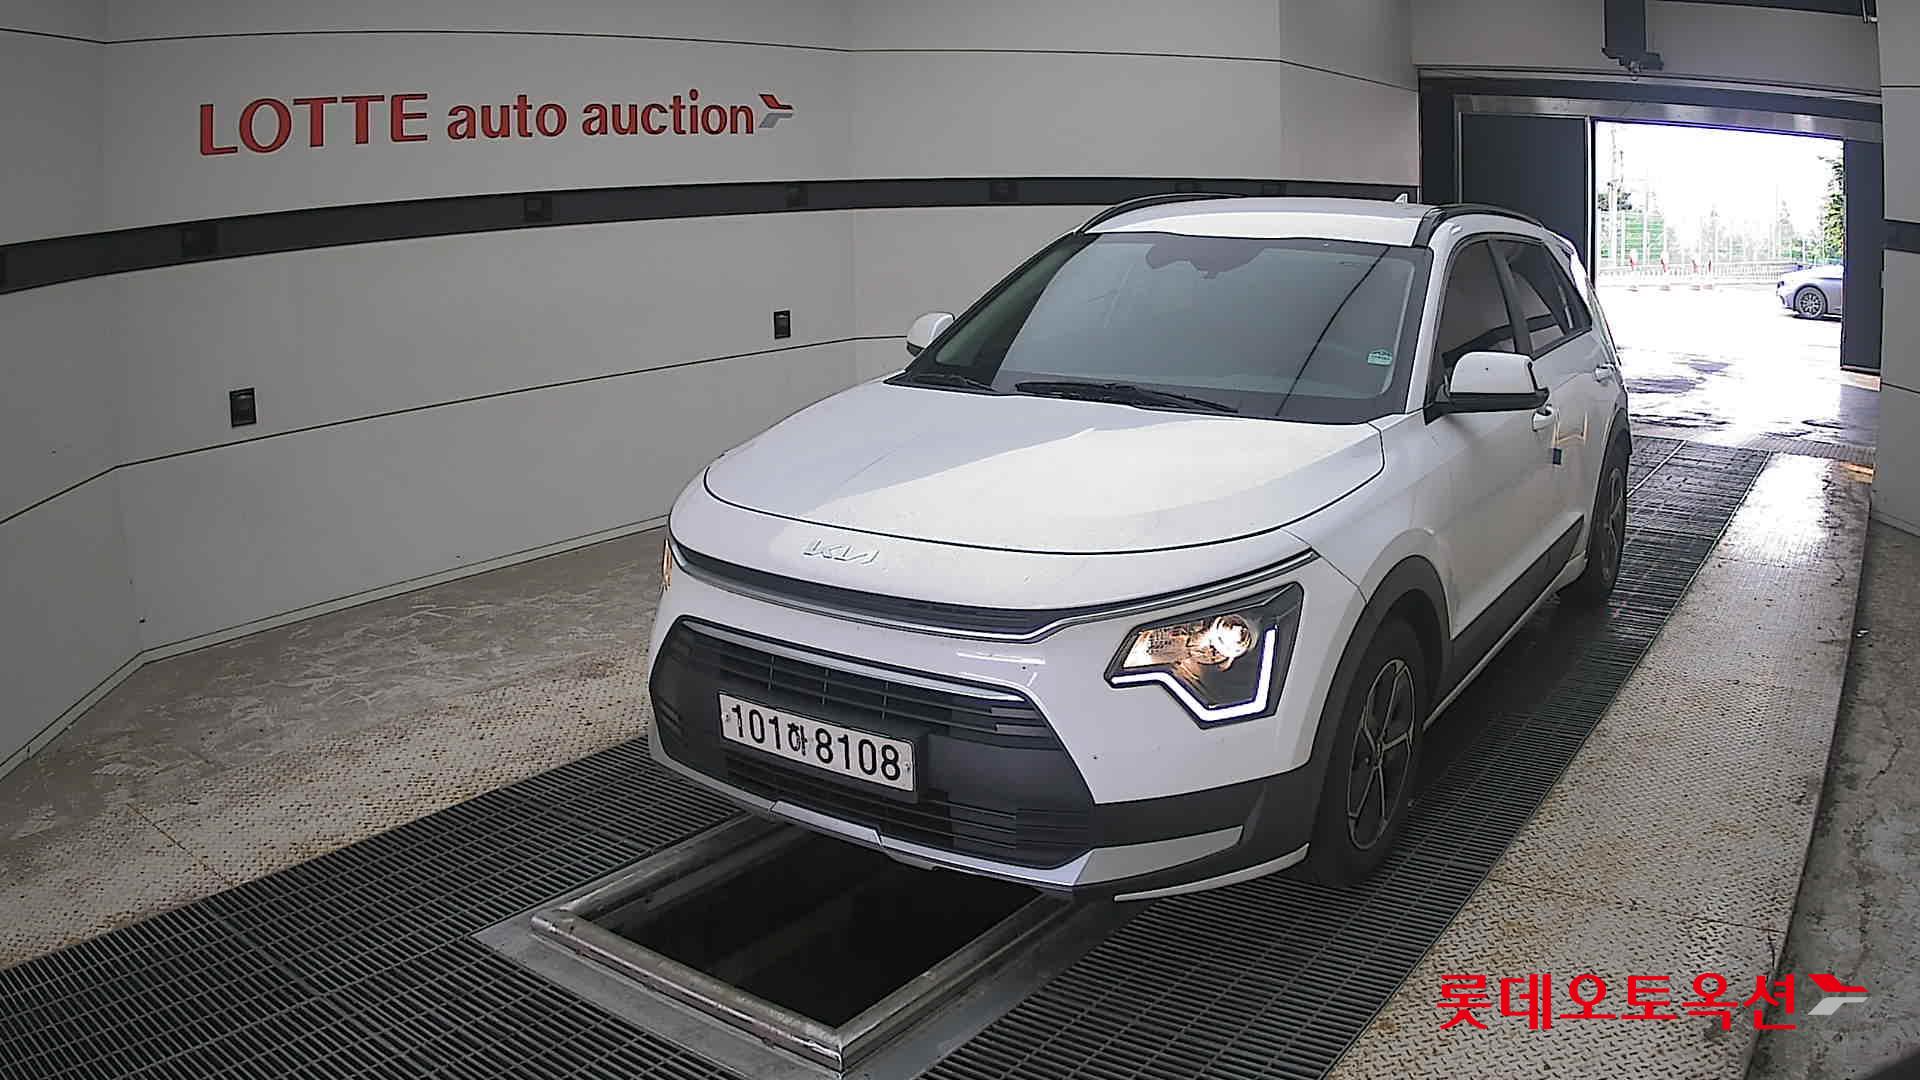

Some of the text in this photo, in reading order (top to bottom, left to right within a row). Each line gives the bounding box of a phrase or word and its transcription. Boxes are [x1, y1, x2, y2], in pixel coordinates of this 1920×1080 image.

[200, 88, 755, 155] LOTTE auto auction
